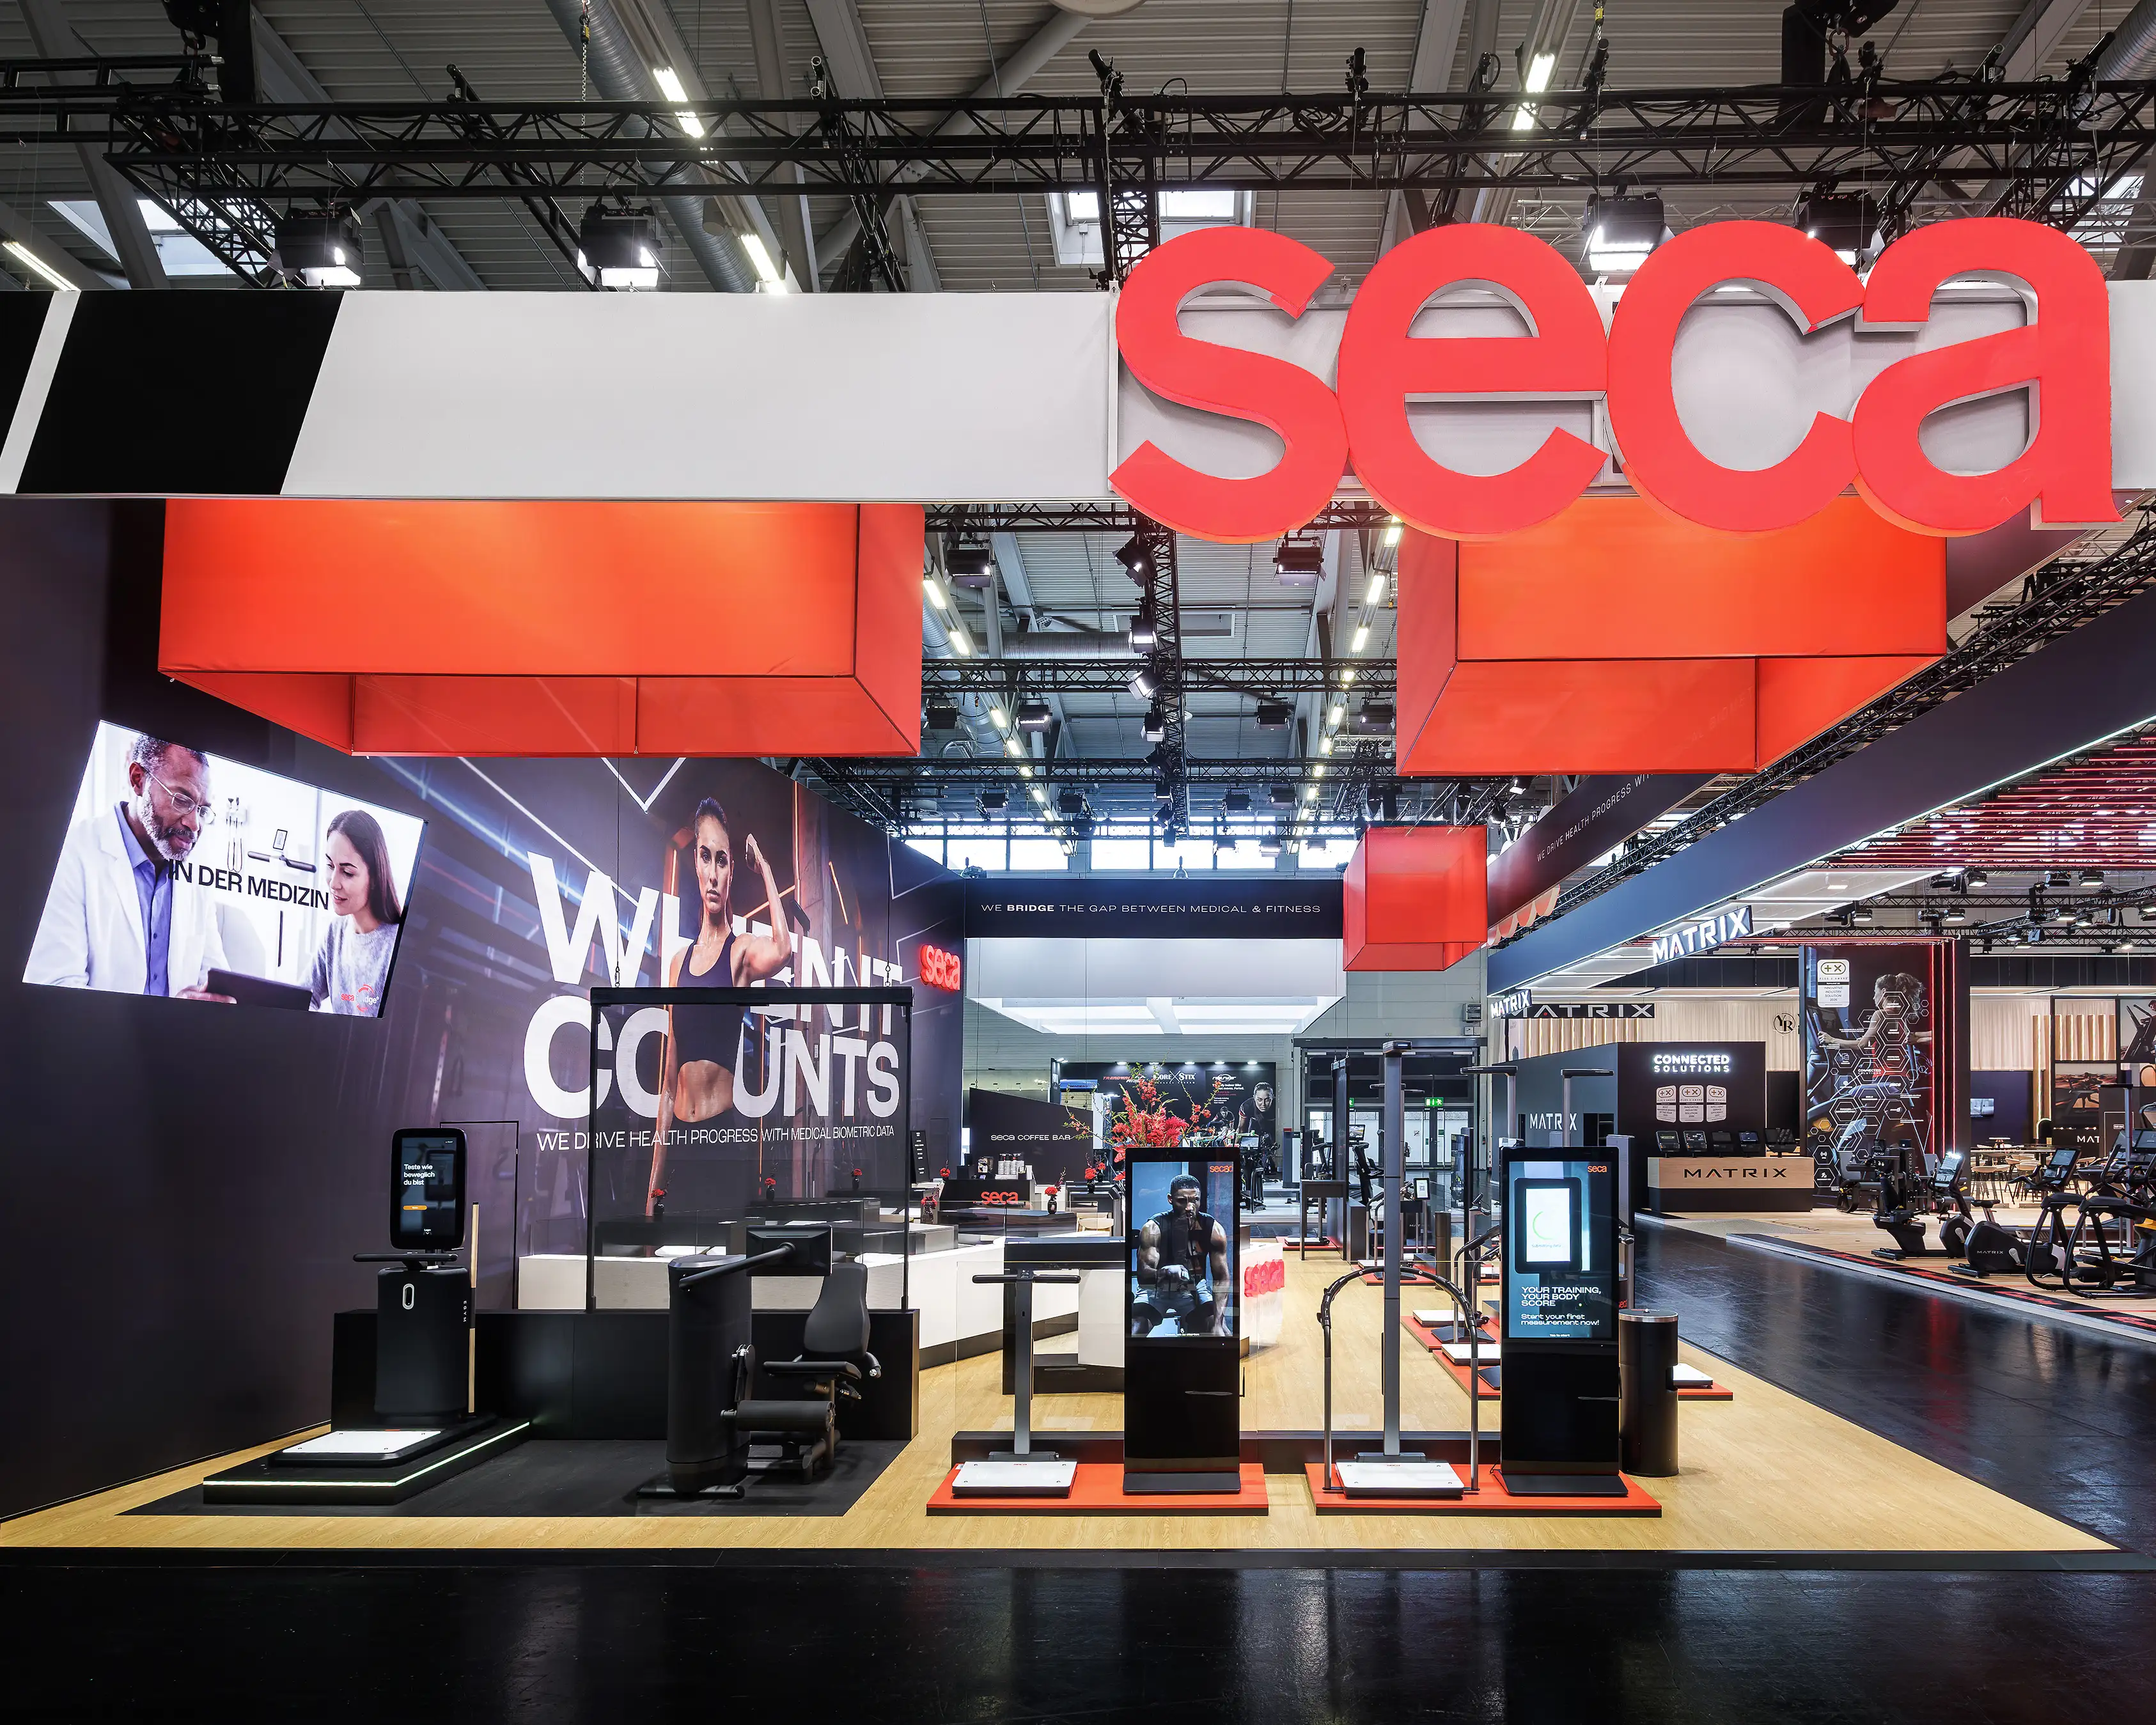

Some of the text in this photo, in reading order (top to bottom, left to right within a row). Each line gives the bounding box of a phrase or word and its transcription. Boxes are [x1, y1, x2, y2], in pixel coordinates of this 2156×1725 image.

[1108, 216, 2122, 543] seca
[1537, 774, 1653, 862] WE DRIVE HEALTH PROGRESS WI
[168, 859, 329, 910] IN DER MEDIZIN
[1652, 906, 1749, 965] MATRIX
[921, 944, 960, 990] seca
[1490, 990, 1529, 1019] MATRIX
[524, 995, 899, 1119] COUNTS
[1653, 1054, 1730, 1065] CONNECTED
[1653, 1065, 1730, 1073] SOLUTIONS
[1529, 1112, 1577, 1131] MATRX
[536, 1132, 570, 1151] WE
[629, 1130, 687, 1148] HEALTH
[691, 1128, 758, 1144] PROGRESS
[760, 1127, 789, 1142] WITH
[791, 1127, 831, 1141] MEDICAL
[832, 1125, 875, 1139] BIOMETRIC
[876, 1125, 894, 1137] DATA
[1587, 1164, 1607, 1173] seca
[1683, 1168, 1787, 1178] MATRIX
[981, 1191, 1019, 1205] seca
[1244, 1259, 1285, 1298] seca
[1551, 1286, 1602, 1295] TRAINING,
